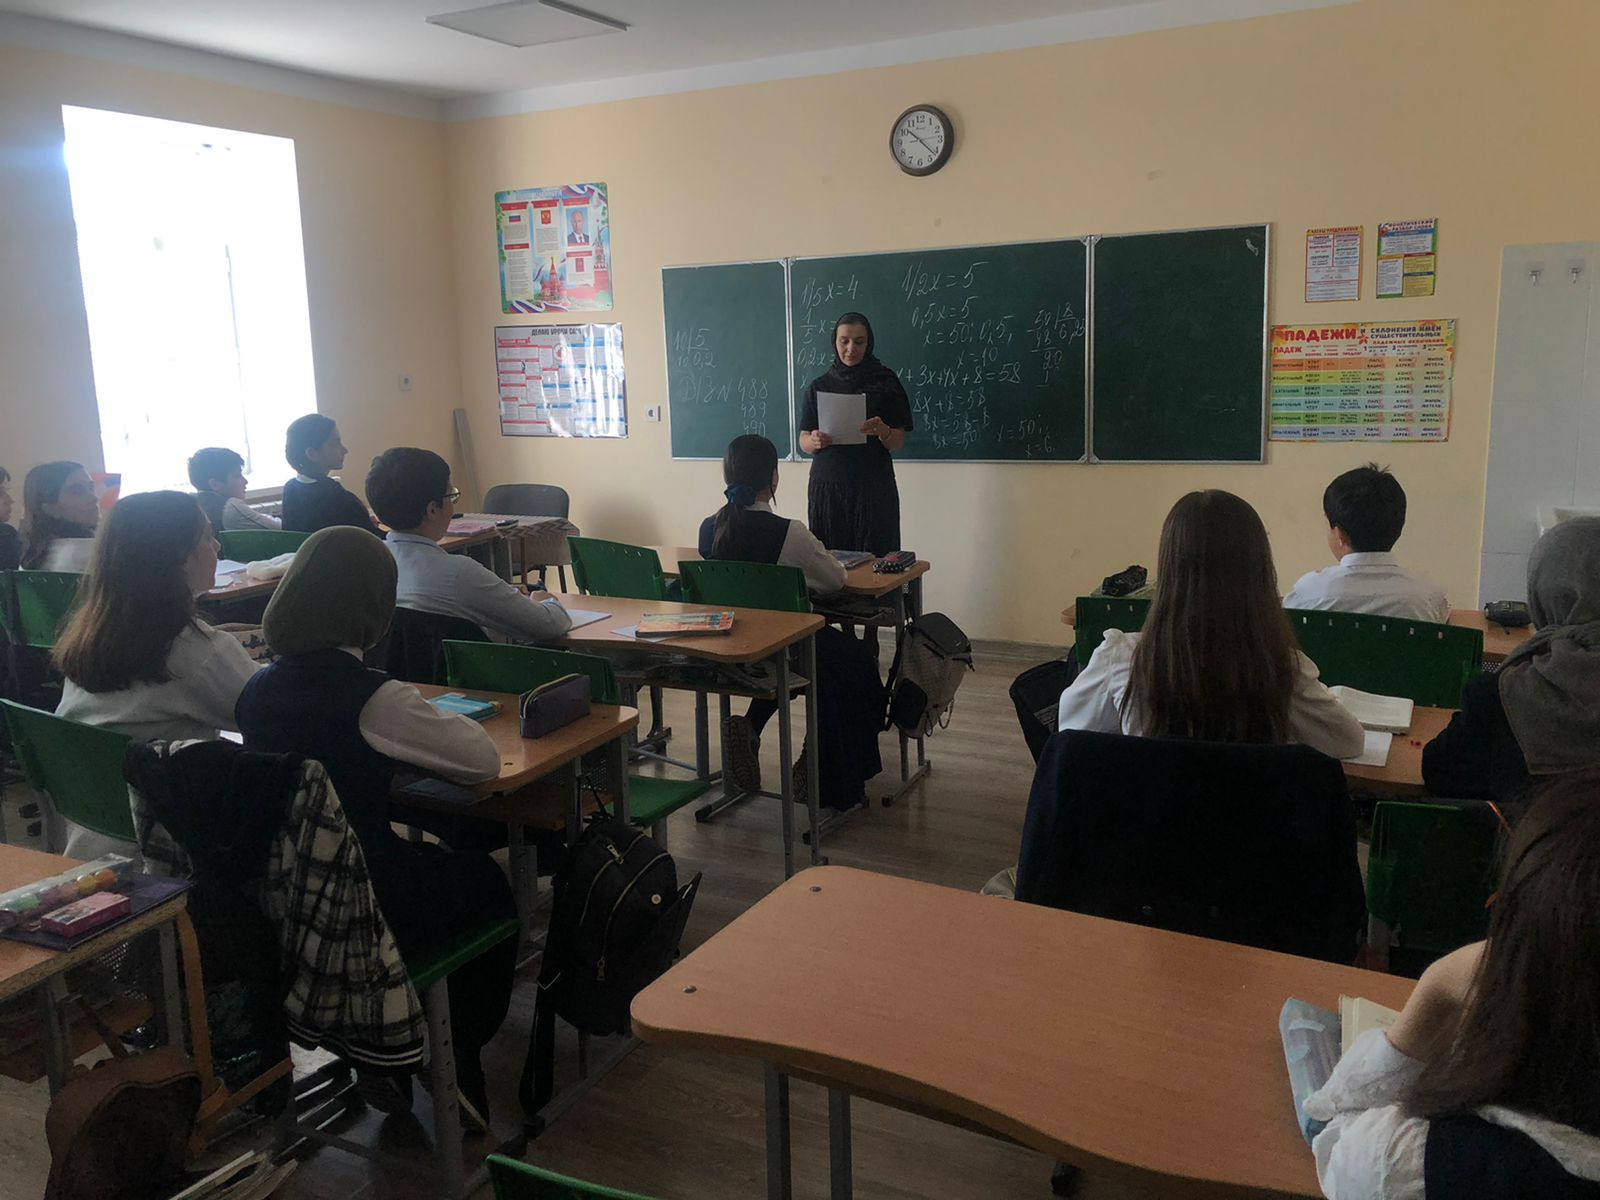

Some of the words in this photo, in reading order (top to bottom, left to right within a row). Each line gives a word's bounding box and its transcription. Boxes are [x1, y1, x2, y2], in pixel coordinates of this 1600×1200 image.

[907, 119, 916, 128] 11
[916, 115, 926, 124] 12
[929, 117, 933, 126] 1
[901, 128, 909, 136] 10
[934, 125, 941, 134] 2
[937, 135, 944, 143] 3
[900, 148, 906, 157] 8
[908, 155, 914, 164] 7
[917, 158, 924, 166] 6
[927, 154, 934, 162] 5
[1284, 328, 1357, 342] ПАДЕЖИ
[1273, 345, 1303, 354] ПАДЕЖ
